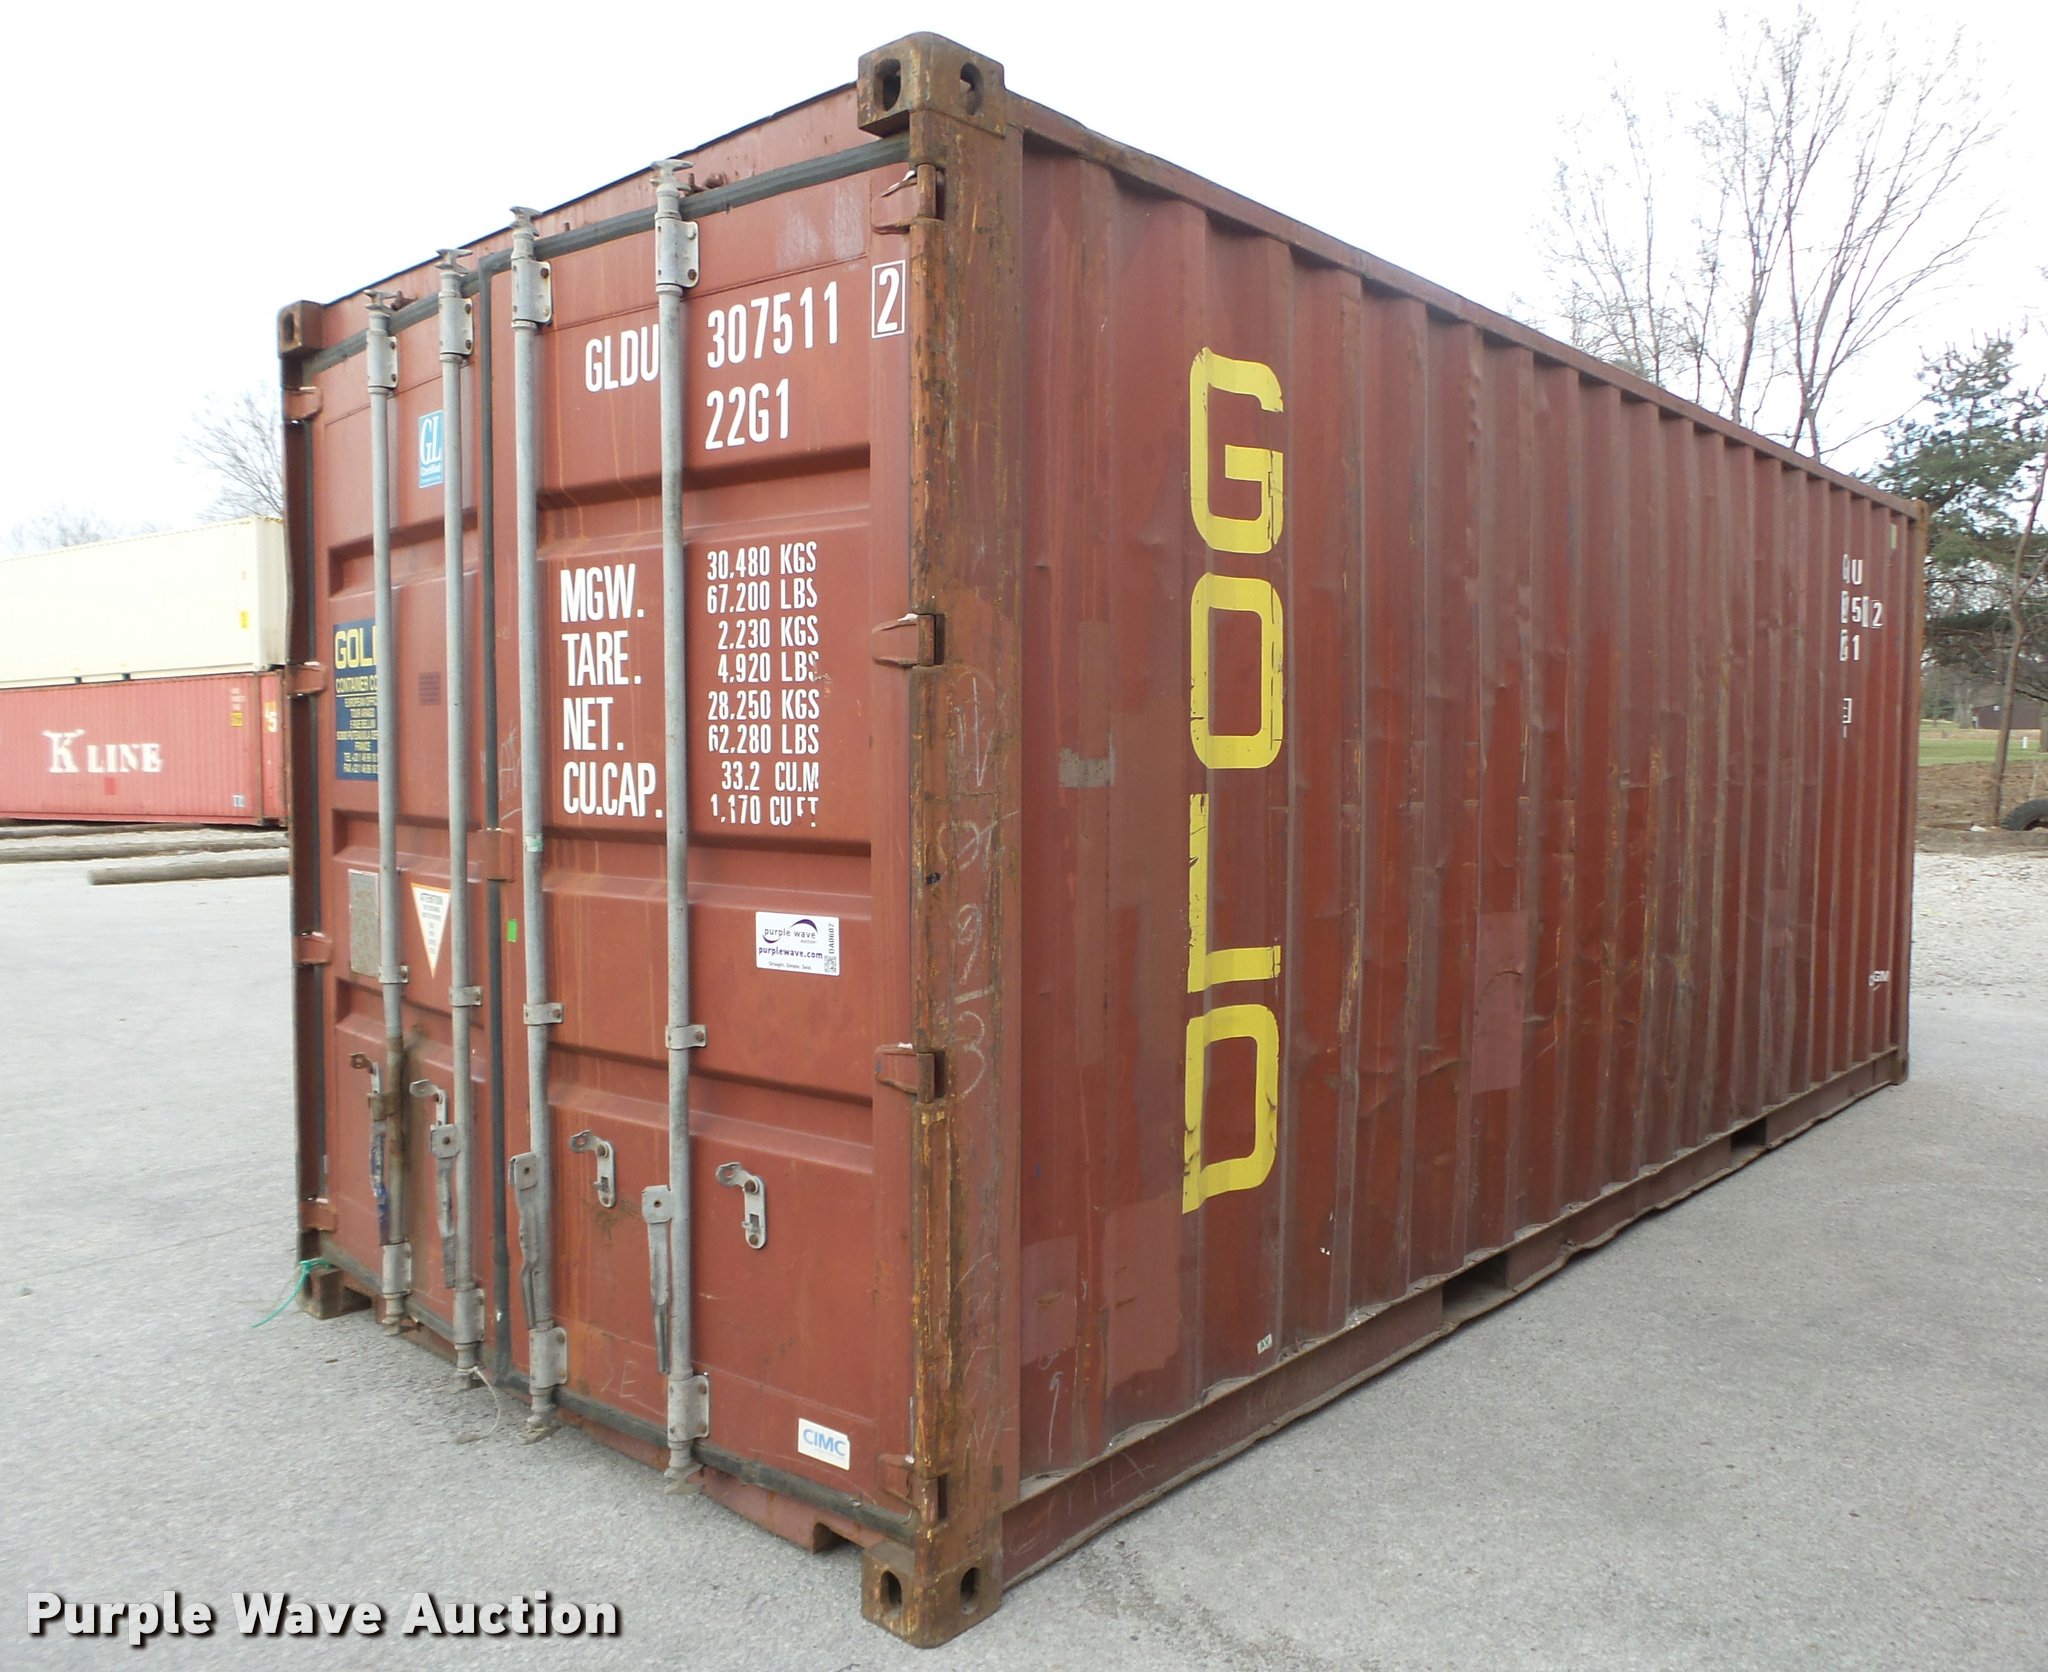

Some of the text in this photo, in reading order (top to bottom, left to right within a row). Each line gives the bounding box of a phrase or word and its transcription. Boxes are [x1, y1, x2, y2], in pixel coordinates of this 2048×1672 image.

[585, 267, 901, 392] GLDU 307511 2
[705, 378, 789, 450] 22G1
[560, 563, 644, 622] MGW.
[780, 541, 817, 574] KGS
[780, 578, 818, 609] LBS
[335, 625, 376, 669] GOL
[561, 630, 642, 687] TARE.
[780, 615, 819, 647] KGS
[781, 650, 819, 682] LBS
[563, 696, 624, 751] NET.
[781, 688, 820, 720] KGS
[781, 723, 819, 755] LBS
[42, 729, 162, 774] K LINE
[721, 760, 760, 791] 33.2
[774, 761, 819, 792] CU.M
[1184, 346, 1285, 1215] GOLD
[758, 946, 823, 959] purplewave.com
[764, 928, 816, 939] purple wave
[803, 1428, 846, 1457] CIMC
